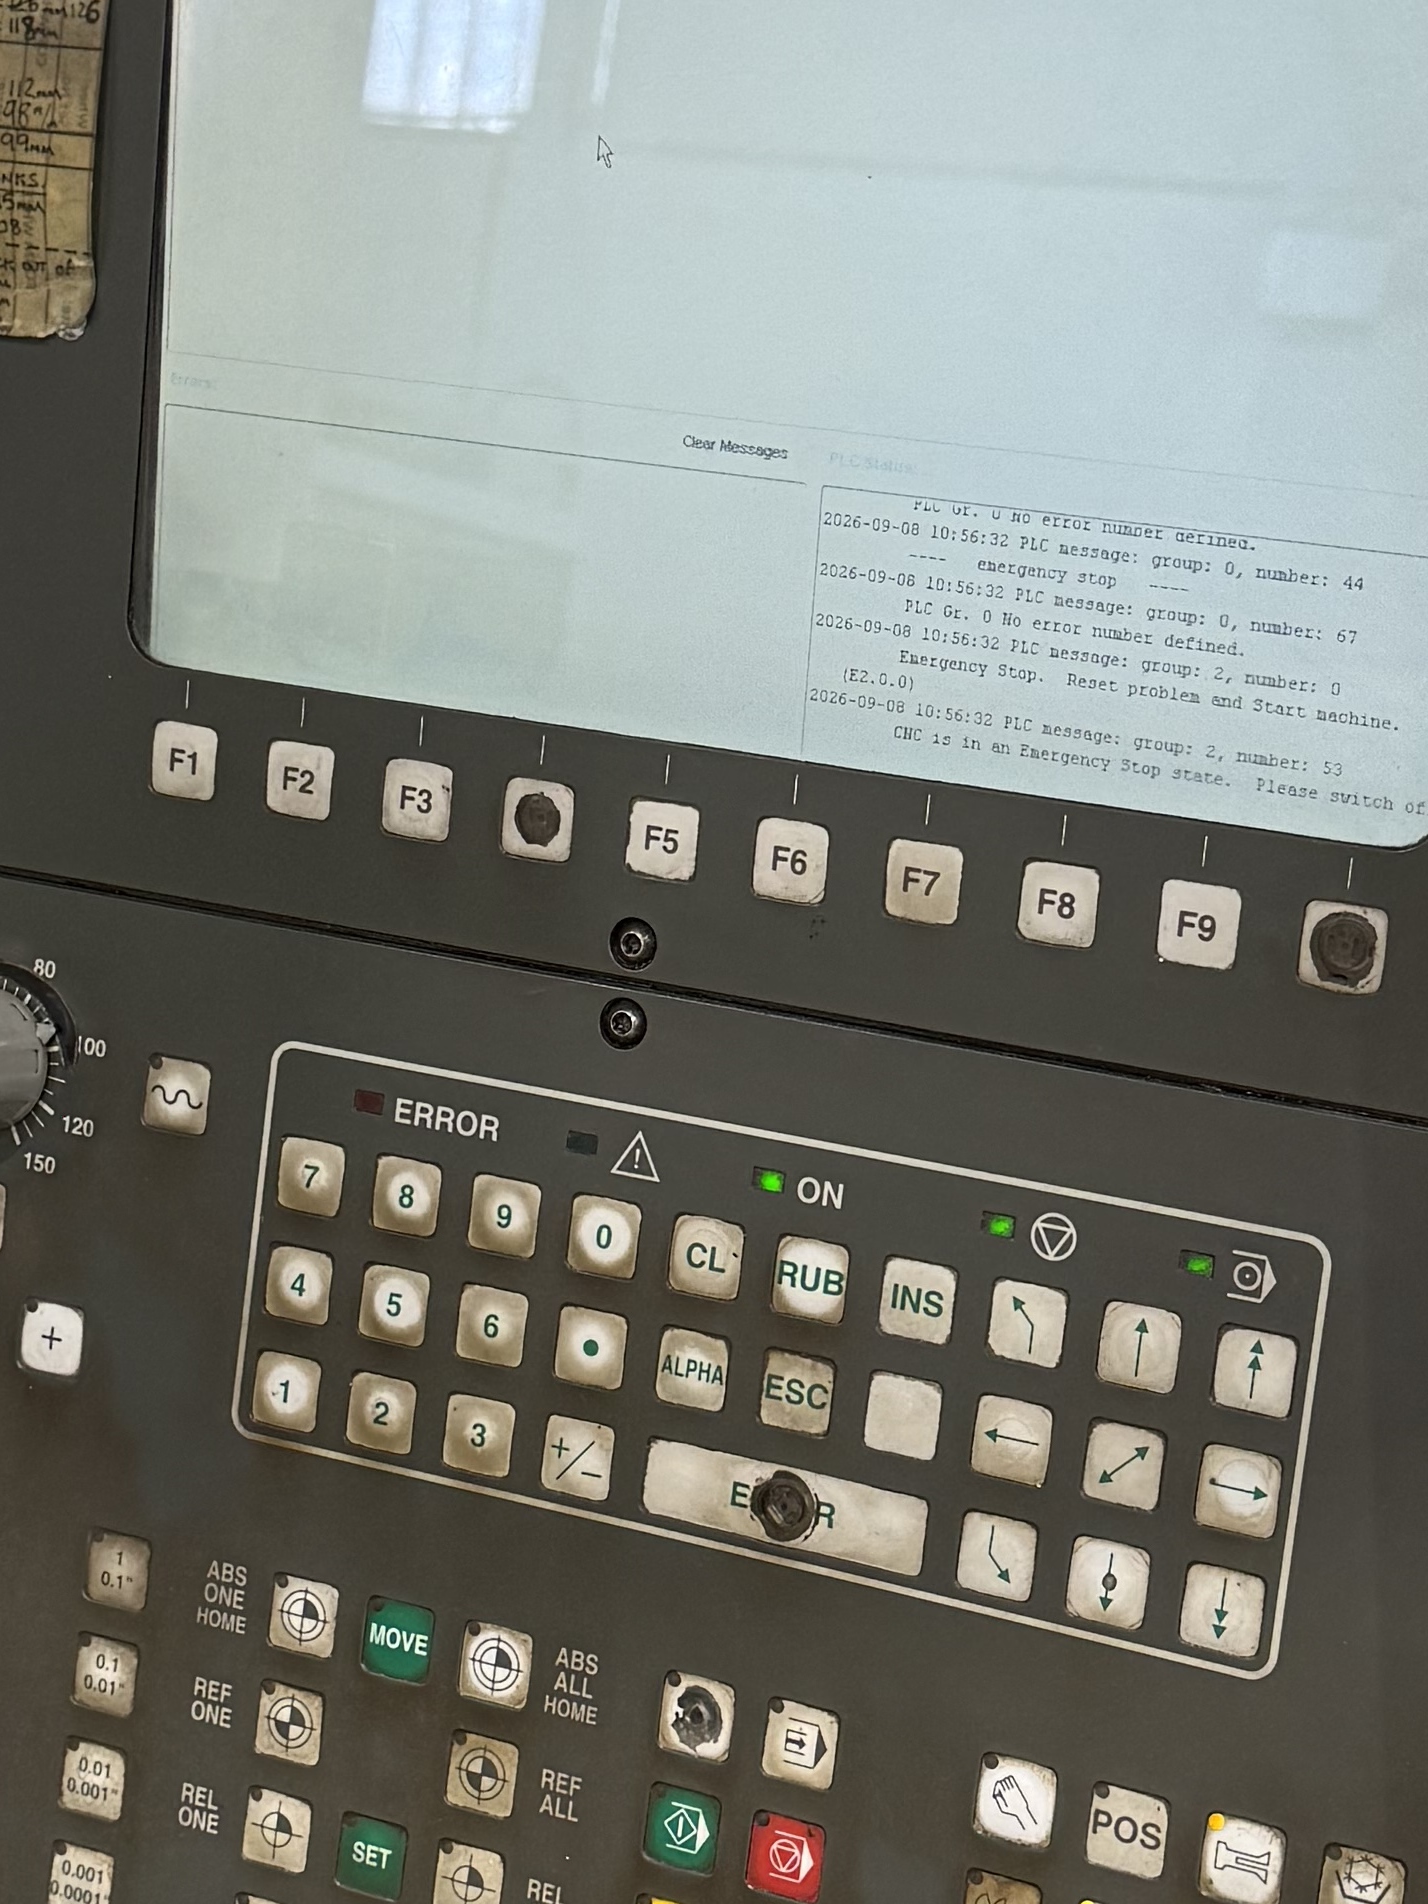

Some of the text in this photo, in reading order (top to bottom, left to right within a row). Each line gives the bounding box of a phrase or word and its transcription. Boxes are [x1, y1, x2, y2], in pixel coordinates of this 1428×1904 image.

[682, 434, 789, 461] Clear Messages
[823, 511, 1363, 590] 2026-09-08 10:56:32 PLC message: group: 0, number: 44
[978, 558, 1120, 591] emergency stop
[819, 562, 1357, 644] 2026-09-08 10:56:32 PLC message: group: 0, number: 67
[904, 598, 935, 616] PLC
[944, 603, 970, 621] Gr.
[983, 608, 994, 624] 0
[1033, 617, 1085, 636] error
[1094, 625, 1156, 645] number
[1165, 631, 1245, 656] defined.
[815, 613, 1341, 695] 2026-09-08 10:56:32 PLC message: group: 2, number: 0
[843, 667, 915, 694] (E2.0.0)
[900, 649, 1397, 730] Emergency Stop. Reset problem and Start machine.
[809, 688, 1343, 775] 2026-09-08 10:56:32 PLC message: group: 2, number: 53
[933, 731, 954, 747] is
[963, 735, 983, 752] in
[992, 742, 1013, 756] an
[1022, 743, 1113, 773] Emergency
[1122, 757, 1164, 781] Stop
[1173, 765, 1231, 786] state.
[1255, 775, 1319, 799] Please
[1328, 788, 1393, 809] switch
[169, 749, 1217, 942] F1 F2 F3 F5 F6 F7 F8 F9
[33, 959, 57, 979] 80
[62, 1115, 94, 1138] 120
[393, 1096, 500, 1142] ERROR
[23, 1152, 56, 1175] 150
[797, 1176, 844, 1210] ON
[685, 1242, 726, 1274] CL
[777, 1260, 944, 1319] RUB INS
[661, 1354, 829, 1410] ALPHA ESC
[206, 1560, 247, 1587] ABS
[204, 1583, 245, 1610] ONE
[196, 1607, 247, 1634] HOME
[369, 1622, 429, 1656] MOVE
[555, 1647, 599, 1675] ABS
[194, 1677, 233, 1703] REF
[553, 1672, 593, 1699] ALL
[190, 1700, 232, 1728] ONE
[543, 1695, 597, 1725] HOME
[541, 1768, 583, 1796] REF
[181, 1783, 219, 1811] REL
[539, 1794, 578, 1822] ALL
[178, 1806, 220, 1835] ONE
[1091, 1809, 1162, 1851] POS
[352, 1842, 392, 1870] SET
